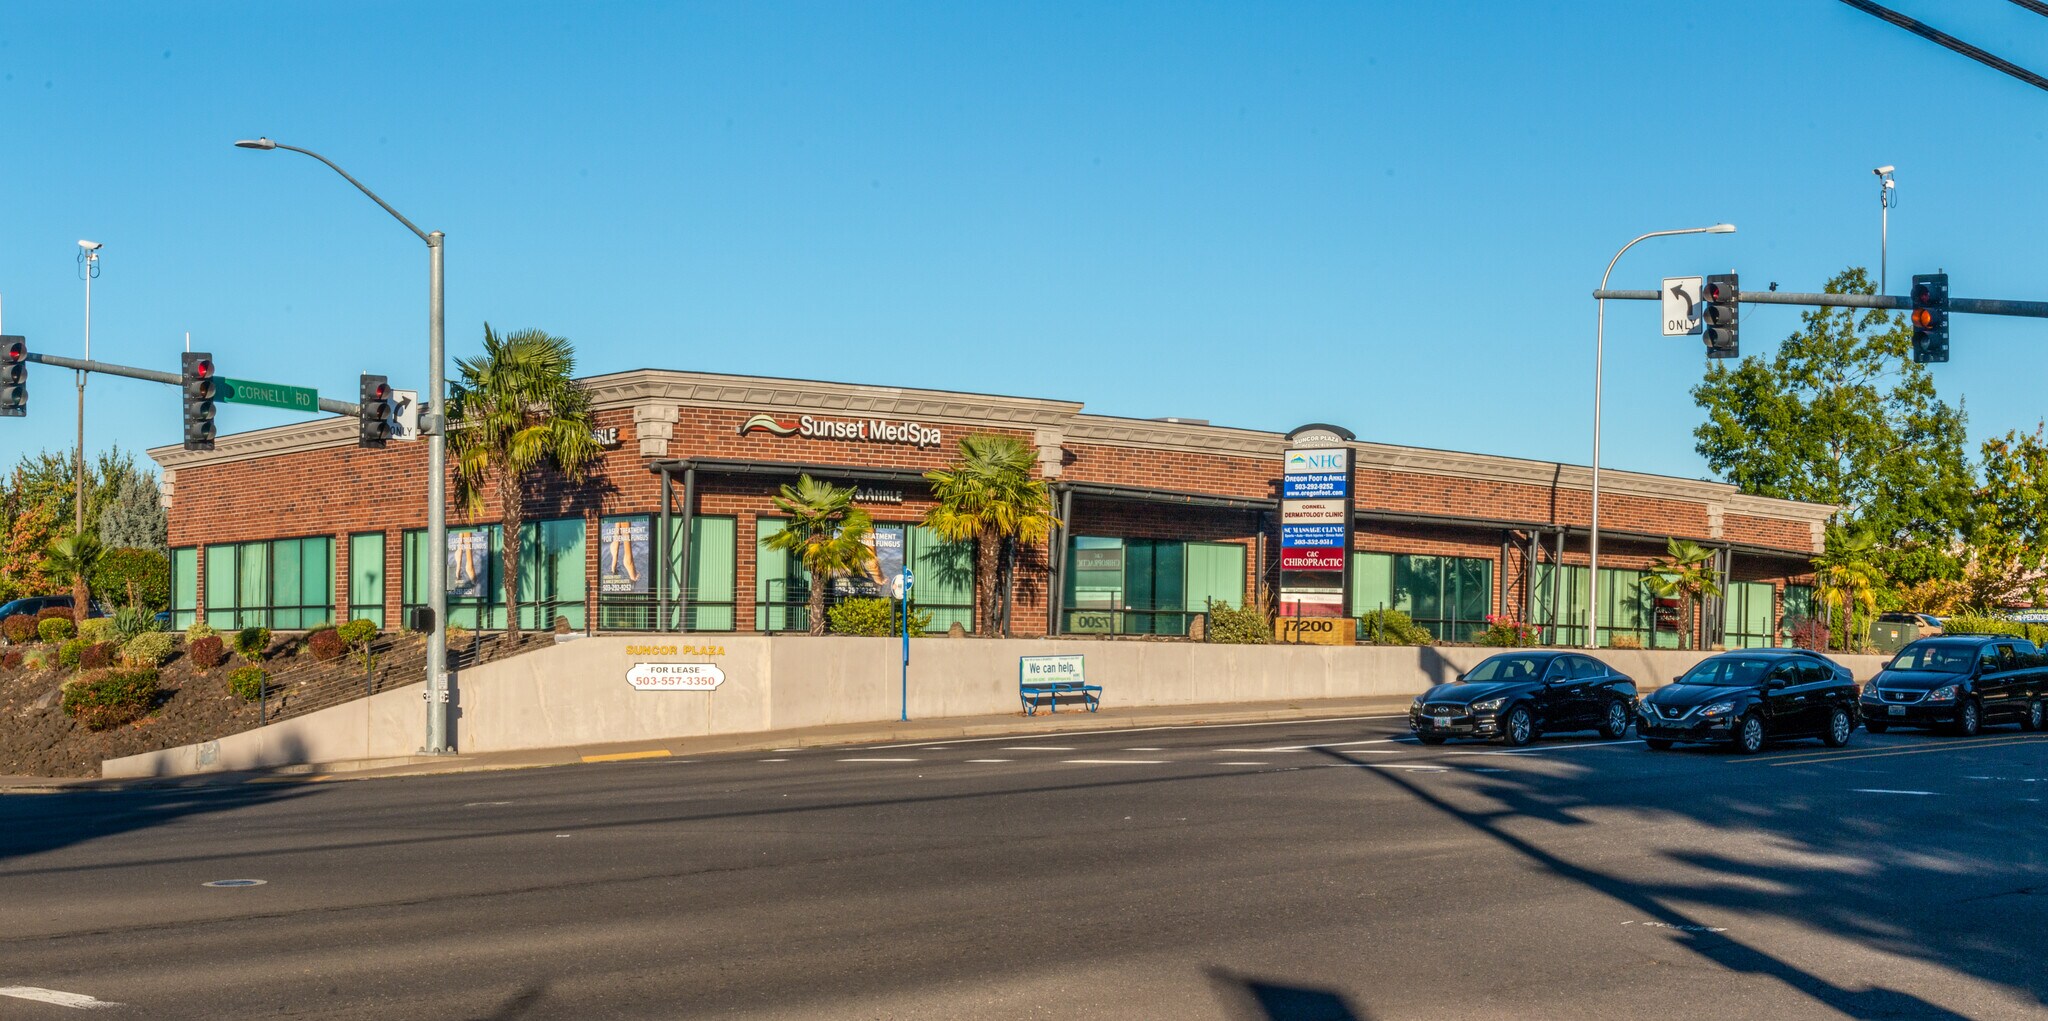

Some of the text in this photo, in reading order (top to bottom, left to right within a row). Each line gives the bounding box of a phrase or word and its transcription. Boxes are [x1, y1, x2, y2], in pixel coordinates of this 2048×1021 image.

[1668, 320, 1697, 331] ONLY
[238, 385, 310, 406] CORNELL RD
[390, 425, 413, 437] ONLY
[800, 415, 941, 447] Sunset MedSpa
[1295, 435, 1339, 445] SUNCOR PLAZA
[1309, 454, 1343, 469] NHC
[1328, 474, 1346, 482] ANKLE
[865, 487, 903, 502] ANKLE
[876, 540, 901, 548] FUNGUS
[1283, 558, 1343, 567] CHIROPRACTIC
[1284, 620, 1333, 633] 17200
[626, 645, 726, 656] SUNCOR PLAZA
[650, 666, 700, 674] FOR LEASE
[1029, 662, 1076, 675] We can help.
[635, 676, 715, 686] 503-557-3350
